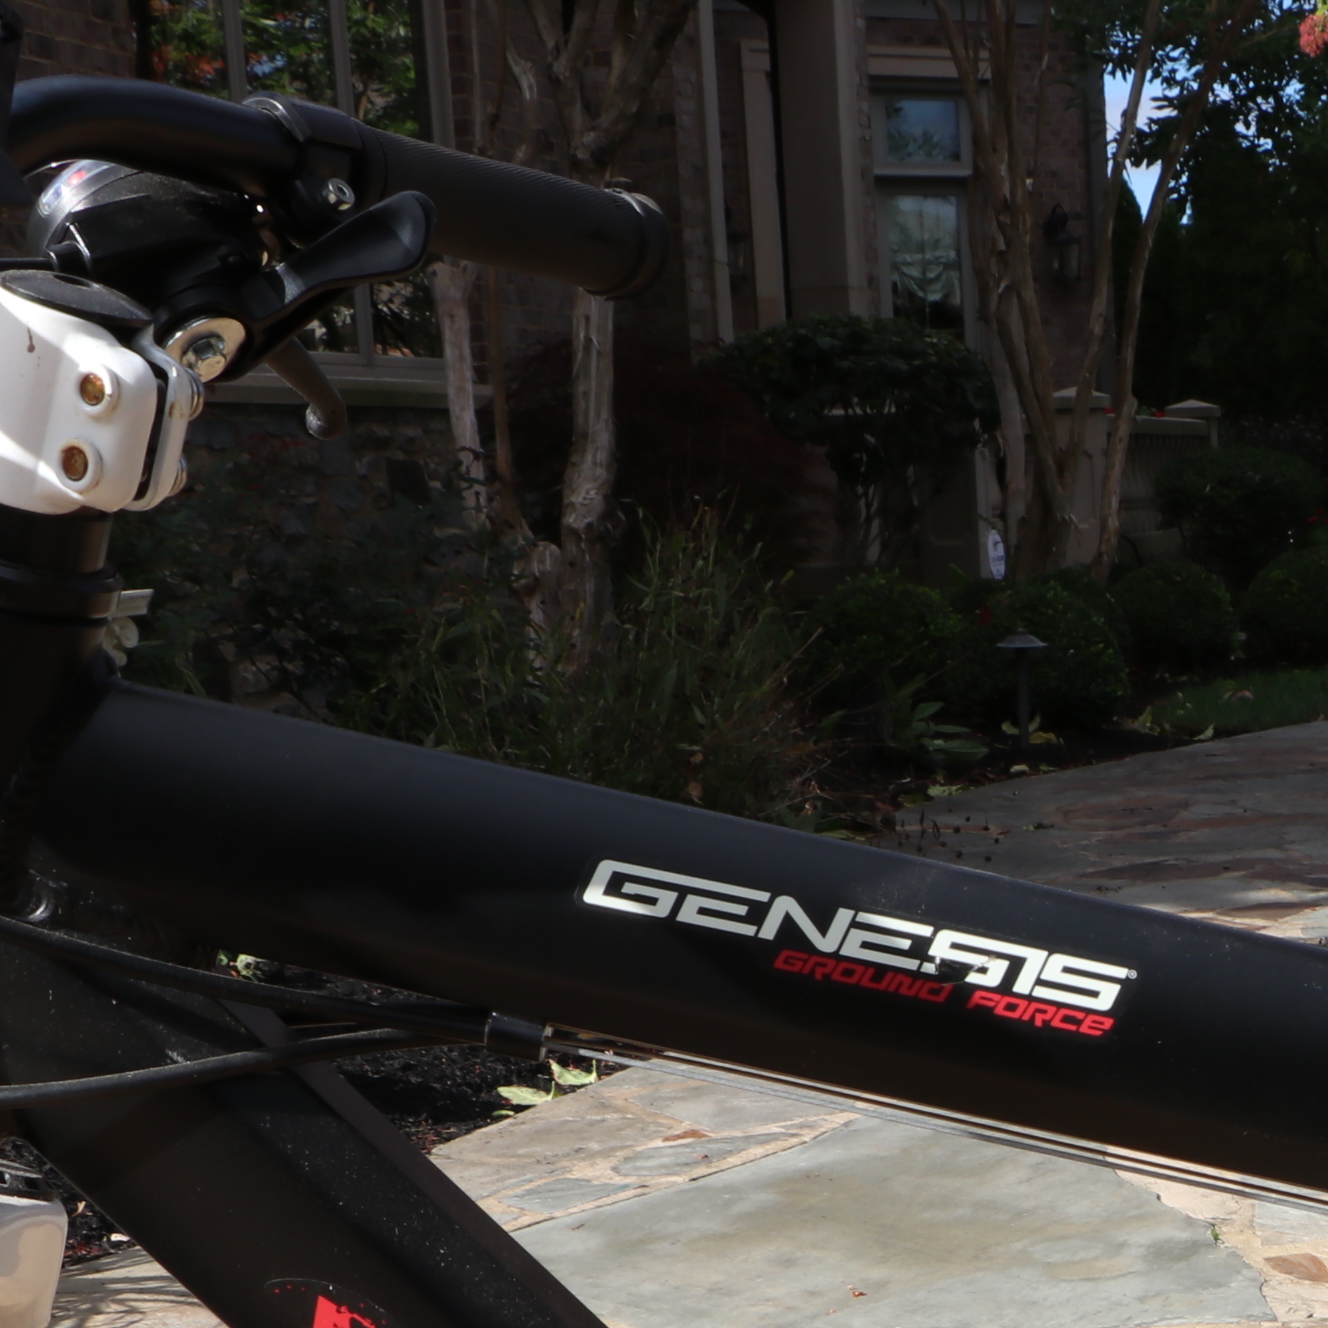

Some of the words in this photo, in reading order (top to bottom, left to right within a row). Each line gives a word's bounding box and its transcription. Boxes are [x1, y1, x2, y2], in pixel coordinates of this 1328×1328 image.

[583, 859, 1129, 1012] GENESIS
[773, 949, 953, 1004] GROUND
[966, 989, 1114, 1037] FORCE
